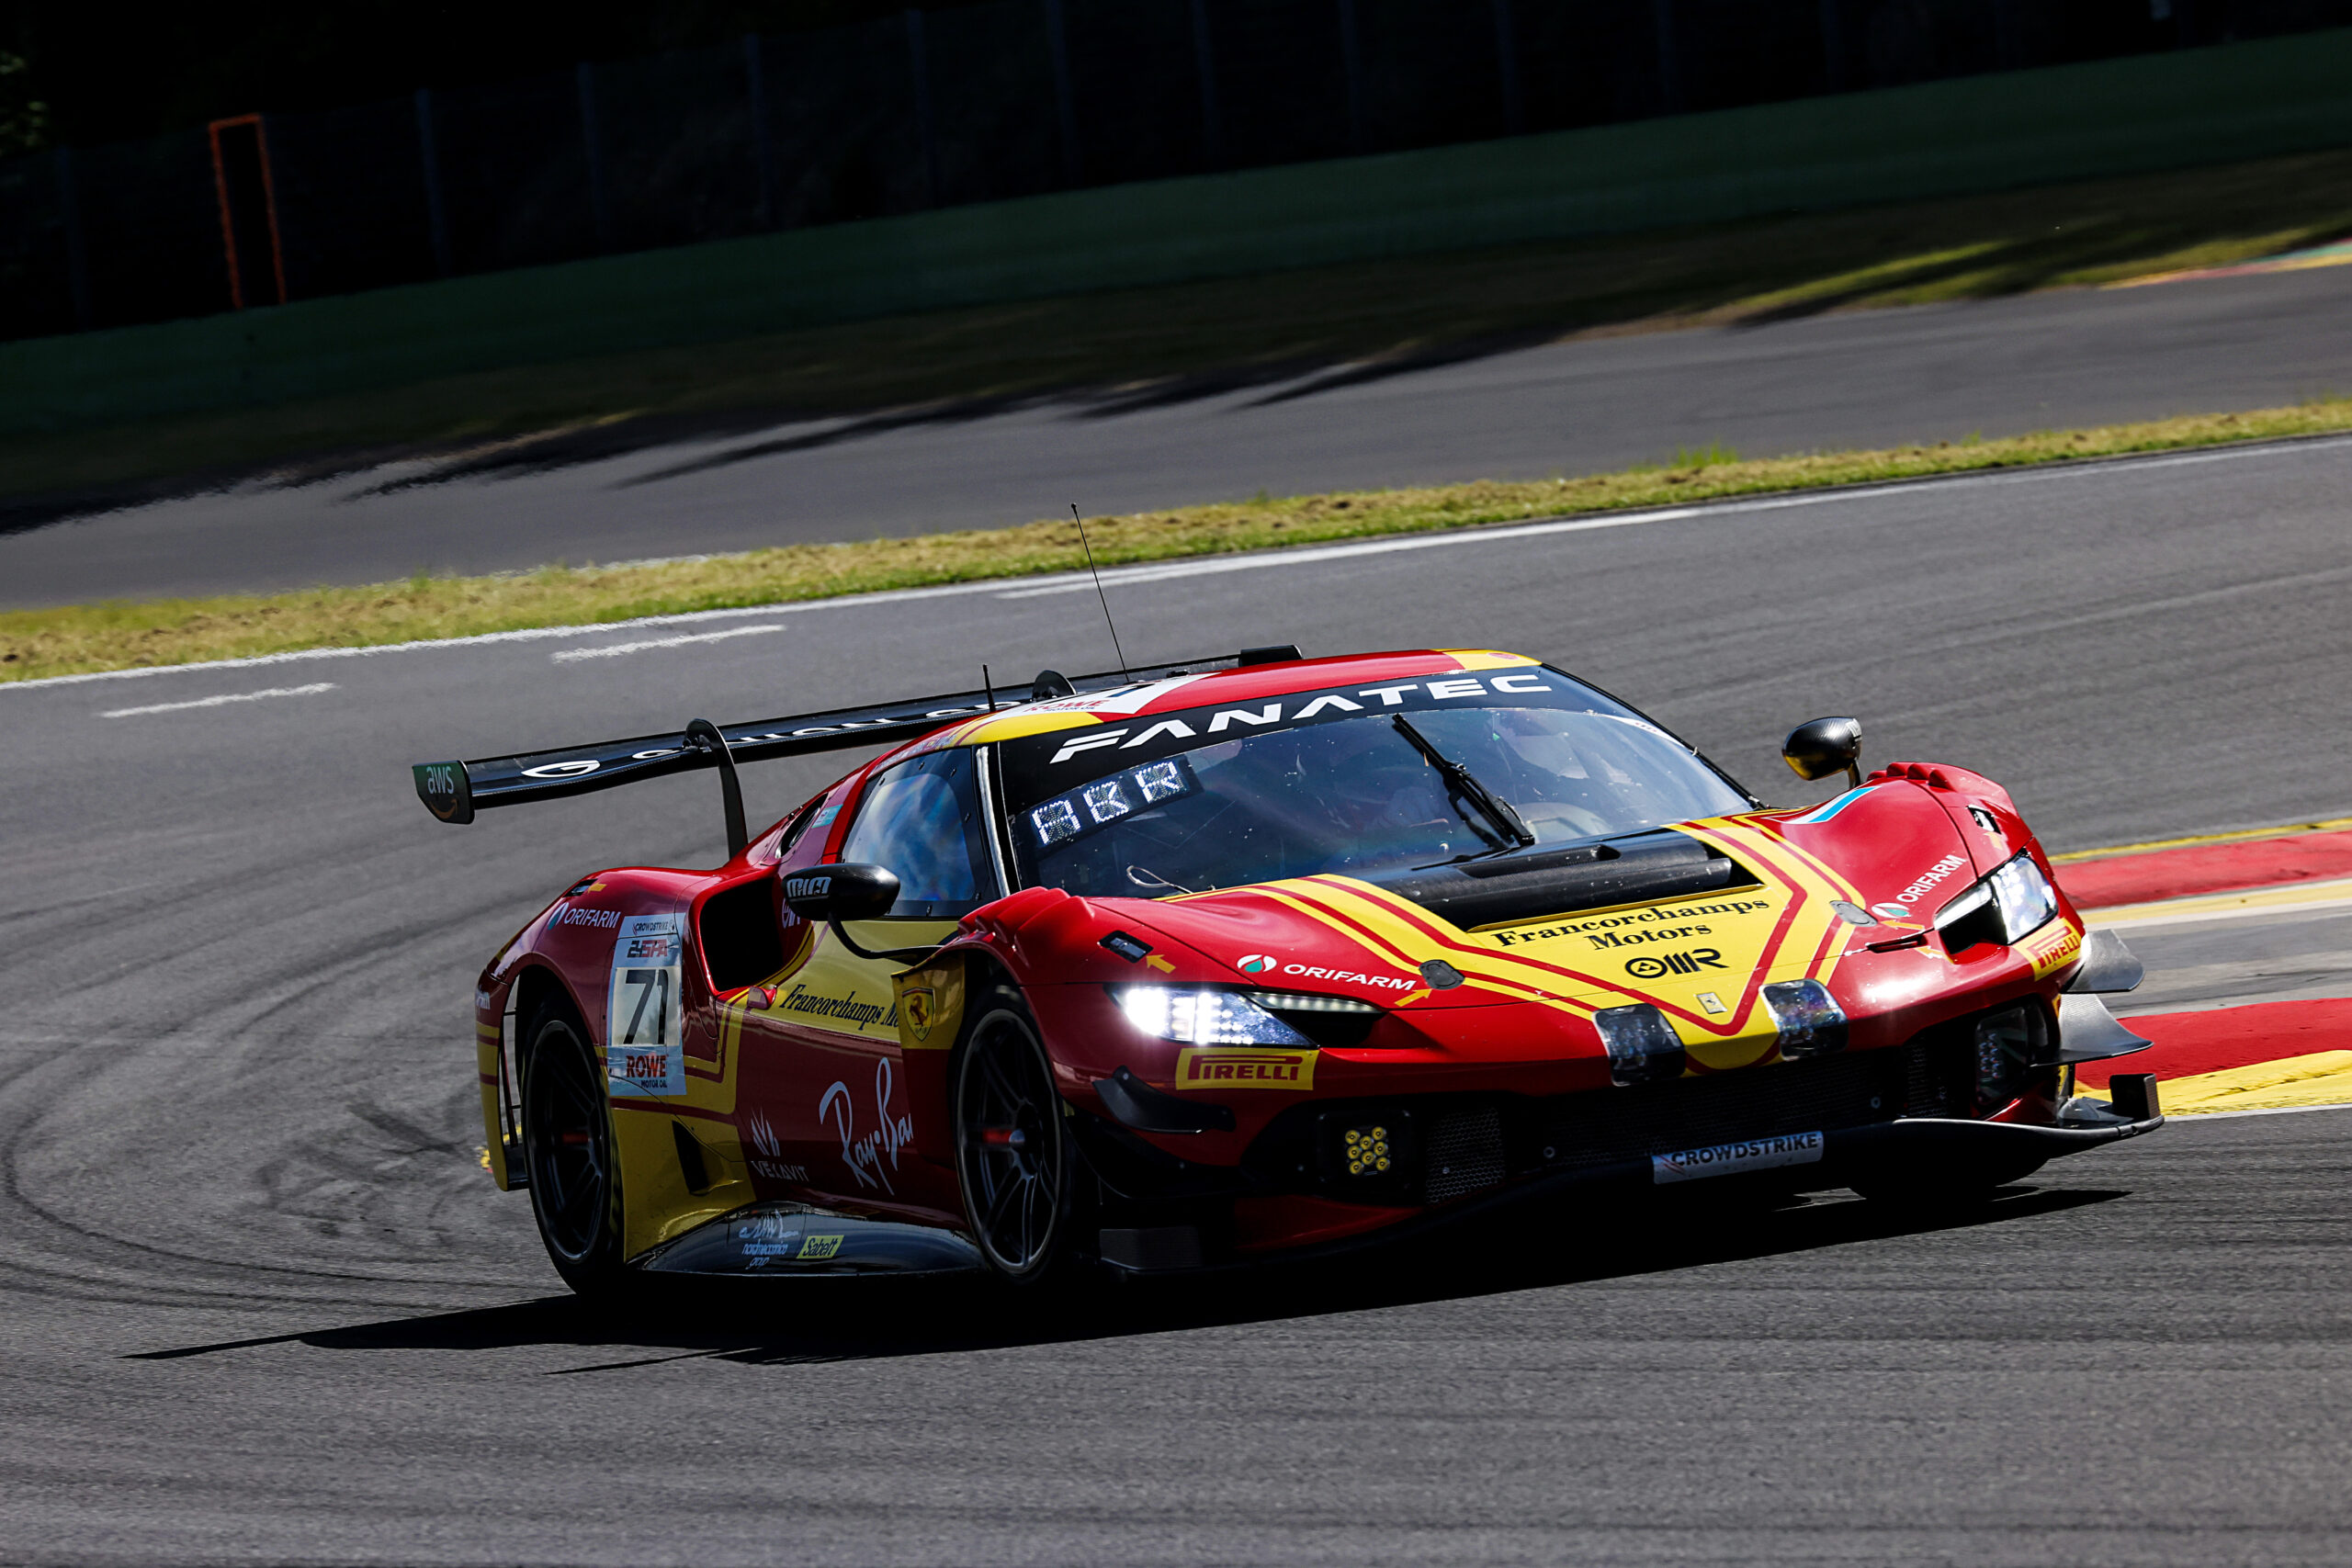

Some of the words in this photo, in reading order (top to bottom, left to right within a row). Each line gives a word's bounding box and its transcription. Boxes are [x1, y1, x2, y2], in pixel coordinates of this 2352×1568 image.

[1049, 674, 1552, 763] FANATEC
[426, 764, 455, 795] aws
[1896, 854, 1968, 903] ORIFARM
[564, 908, 621, 929] ORIFARM
[635, 921, 669, 932] CROWDSTRIKE
[1491, 897, 1770, 947] Francorchamps
[1583, 924, 1712, 951] Motors
[2026, 925, 2081, 969] PIRELLI
[1283, 964, 1417, 991] ORIFARM
[623, 969, 669, 1044] 71
[779, 984, 884, 1031] Francorchamps
[626, 1055, 668, 1078] ROWE
[1187, 1055, 1303, 1081] PIRELLI
[641, 1079, 658, 1089] MOTOR
[1671, 1133, 1818, 1167] CROWDSTRIKE
[802, 1237, 839, 1258] Sabelt
